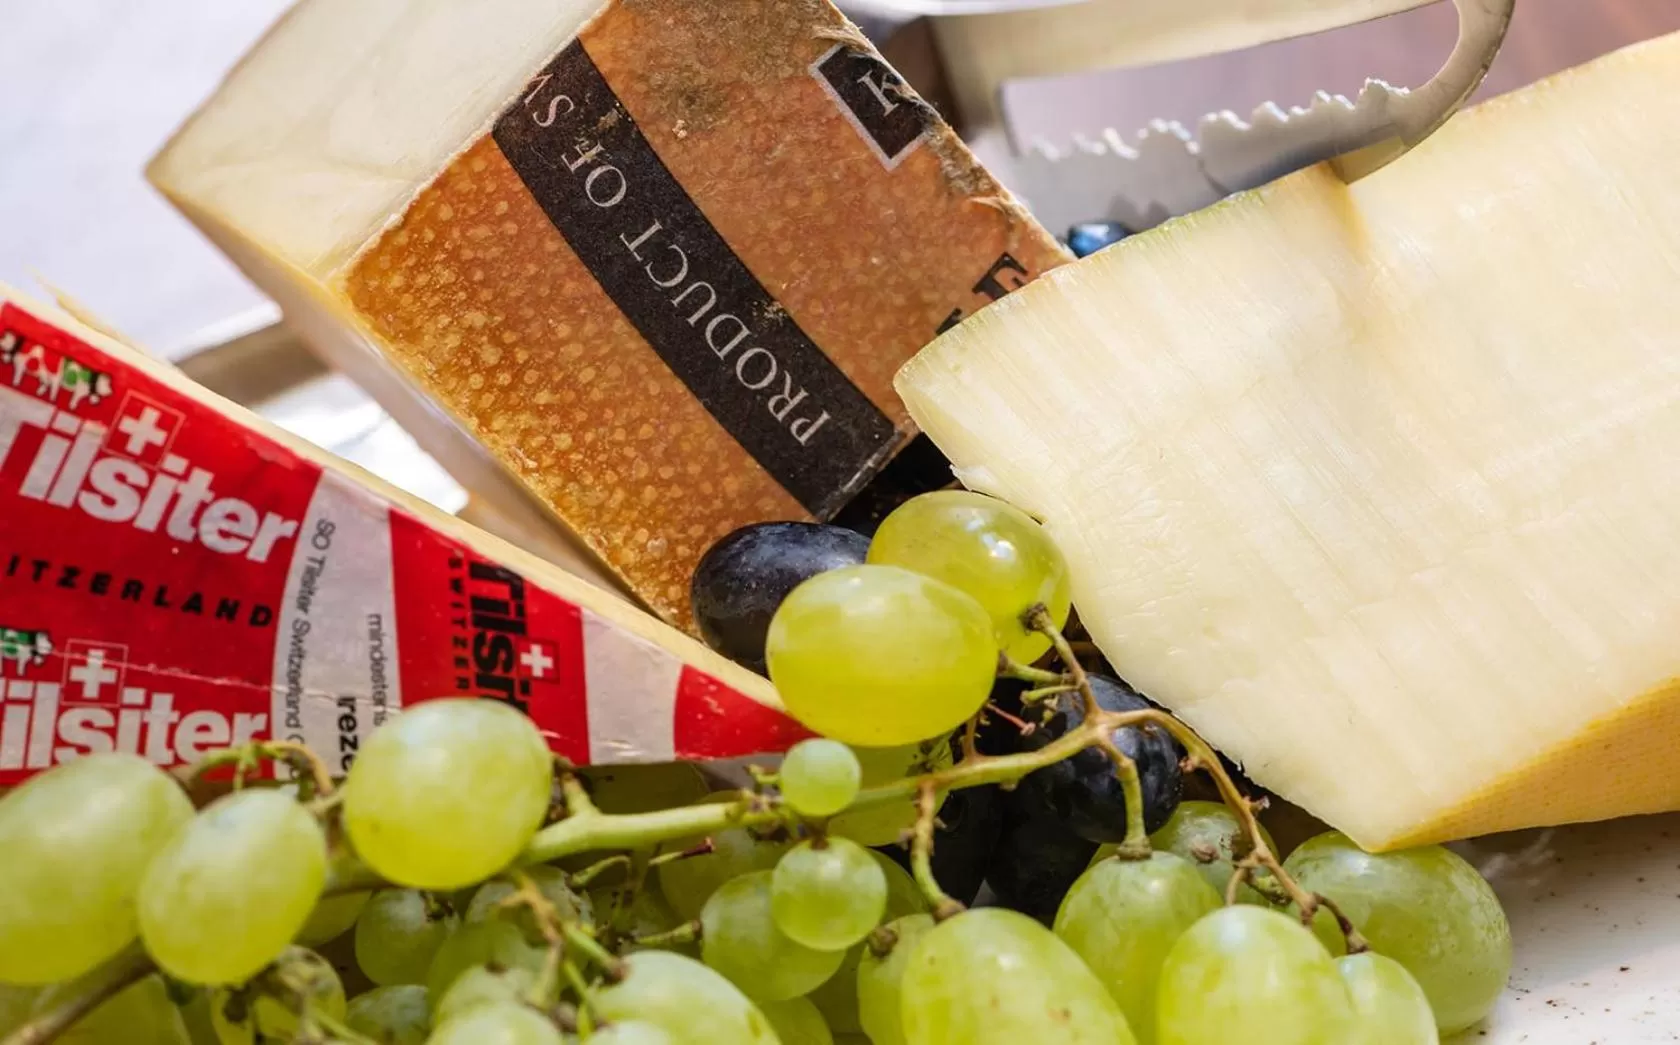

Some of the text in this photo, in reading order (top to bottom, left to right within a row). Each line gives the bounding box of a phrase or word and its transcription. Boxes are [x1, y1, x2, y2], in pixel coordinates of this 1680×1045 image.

[561, 141, 628, 208] OF
[619, 218, 831, 447] PRODUCT
[310, 518, 337, 551] SO
[295, 555, 328, 615] Tilsiter
[285, 617, 312, 729] Switzerland
[0, 675, 269, 770] ilsiter
